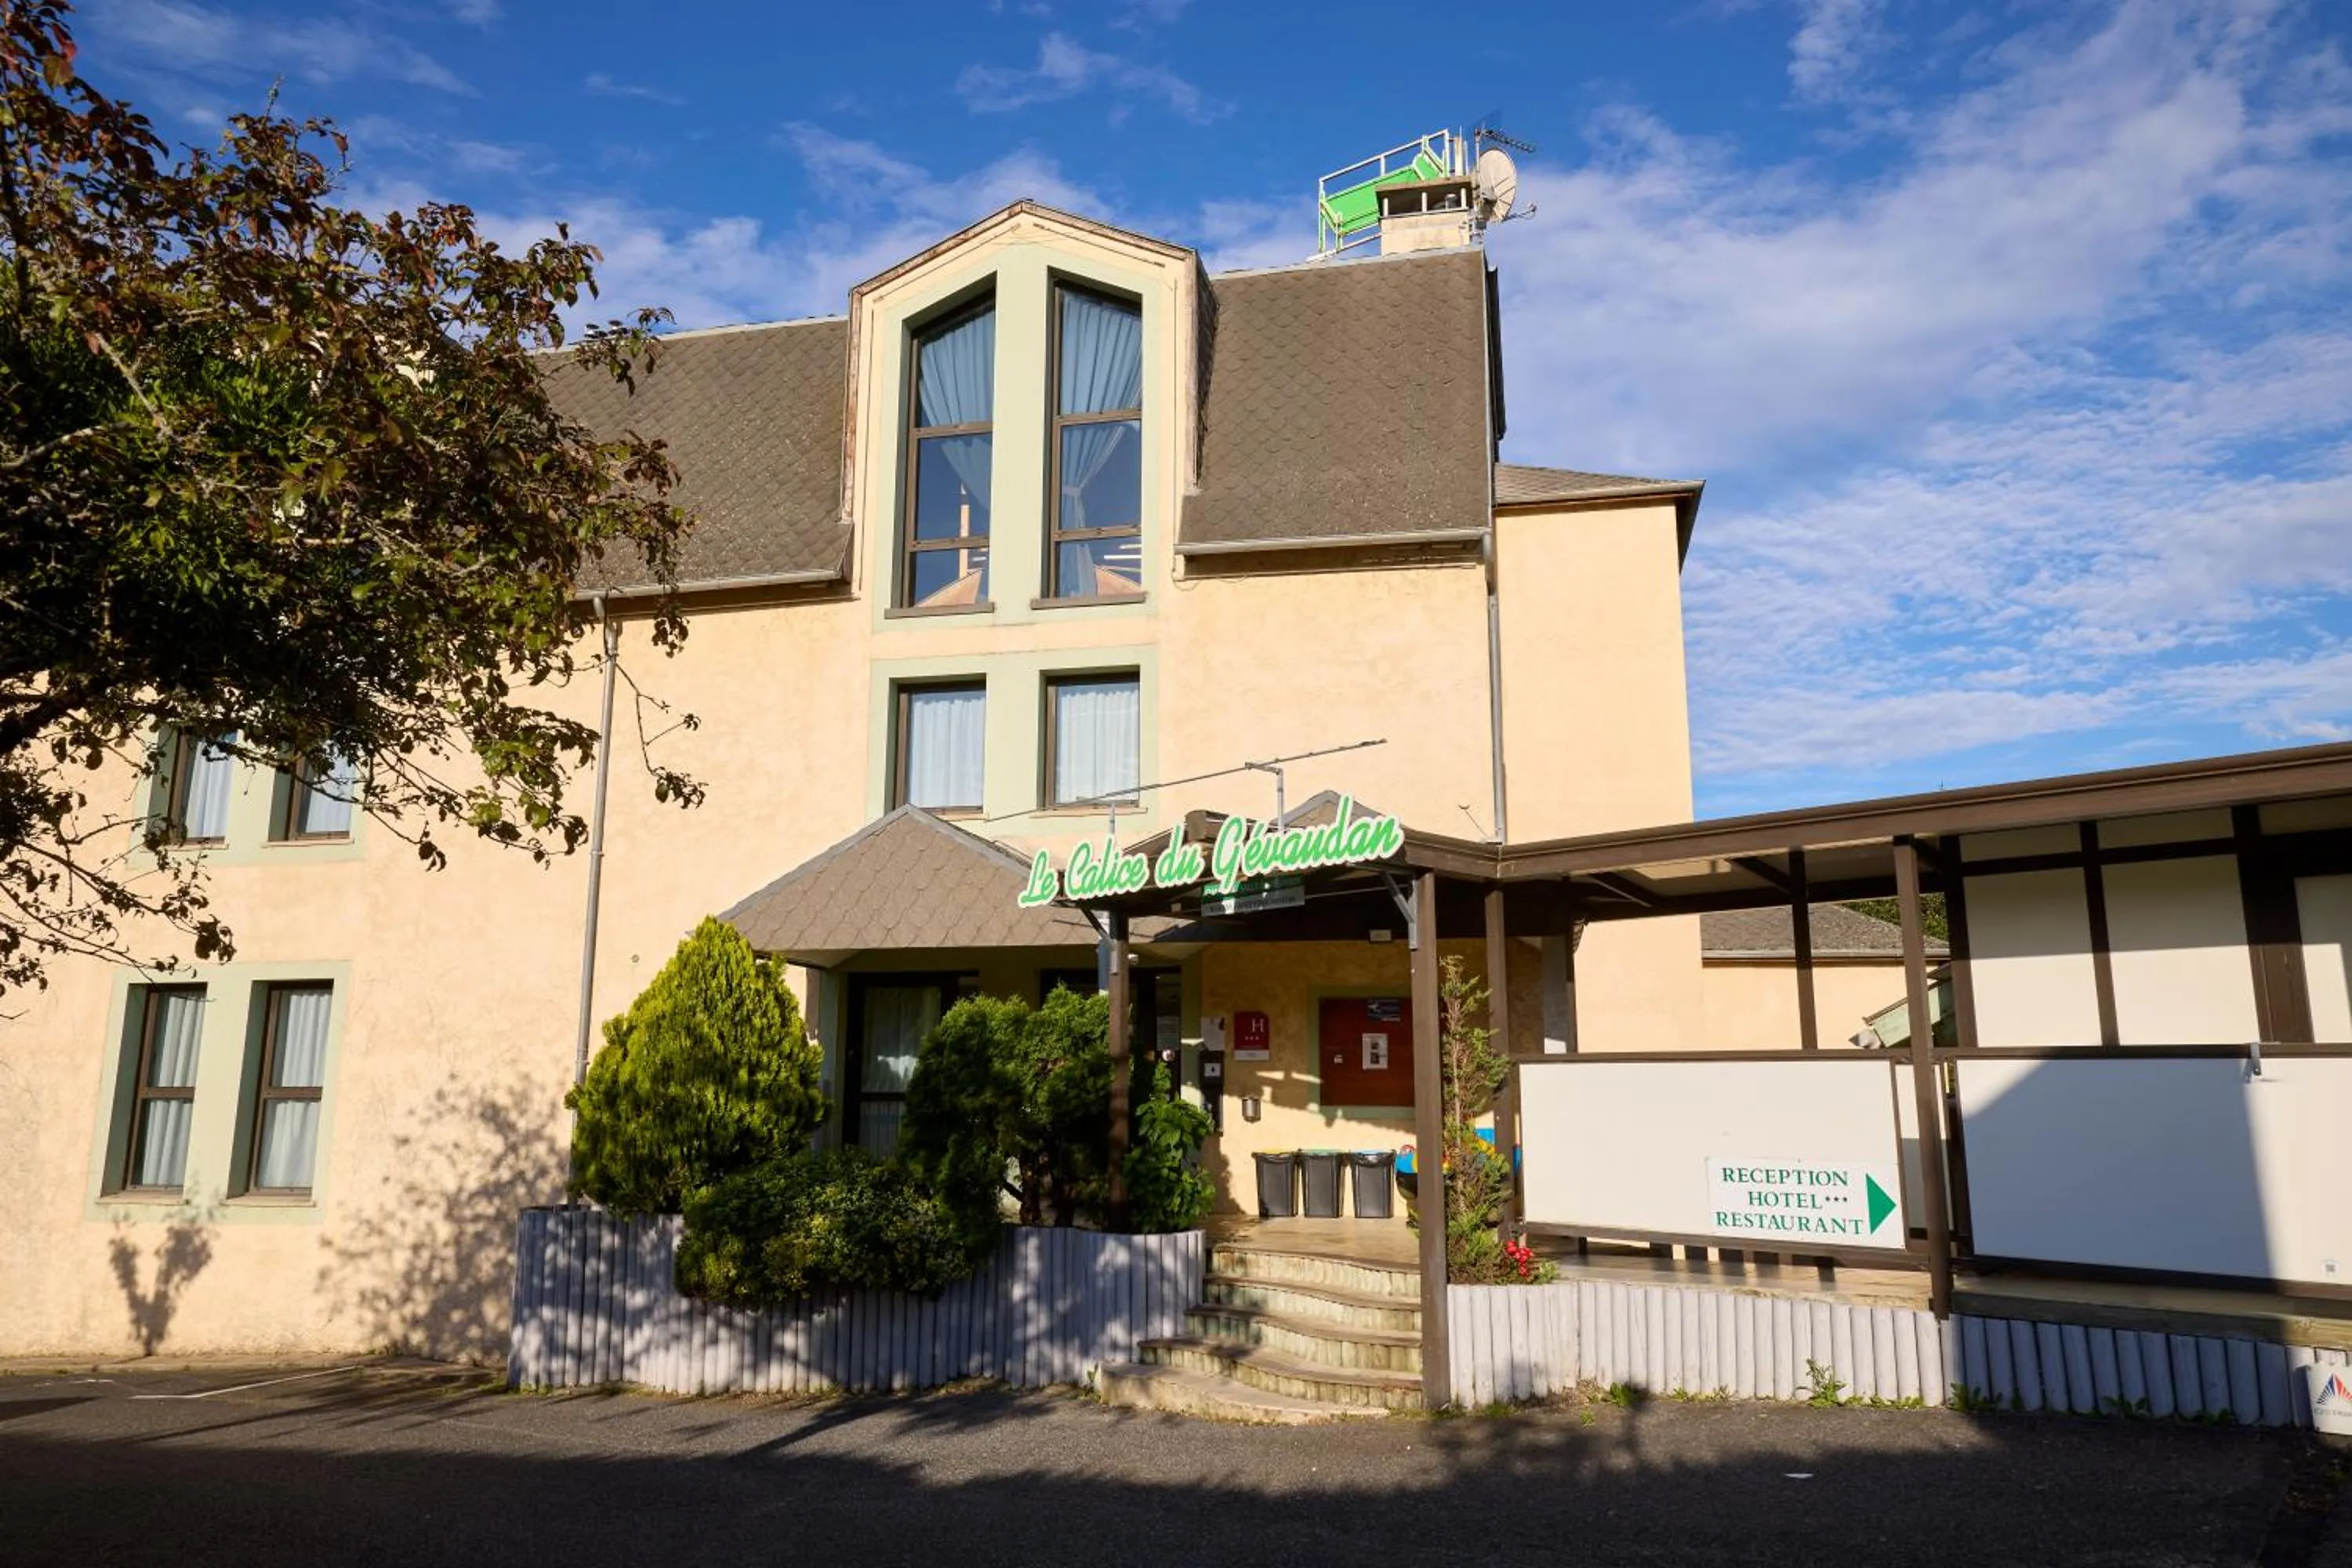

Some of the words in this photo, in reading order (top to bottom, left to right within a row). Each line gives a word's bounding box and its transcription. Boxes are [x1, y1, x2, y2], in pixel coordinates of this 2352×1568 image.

[1019, 849, 1058, 906] Le
[1065, 835, 1149, 899] Calice
[1156, 823, 1204, 887] du
[1213, 794, 1404, 894] Gévaudan
[1251, 1018, 1265, 1033] H
[1722, 1167, 1848, 1186] RECEPTION
[1748, 1191, 1823, 1210] HOTEL
[1715, 1211, 1864, 1235] RESTAURANT
